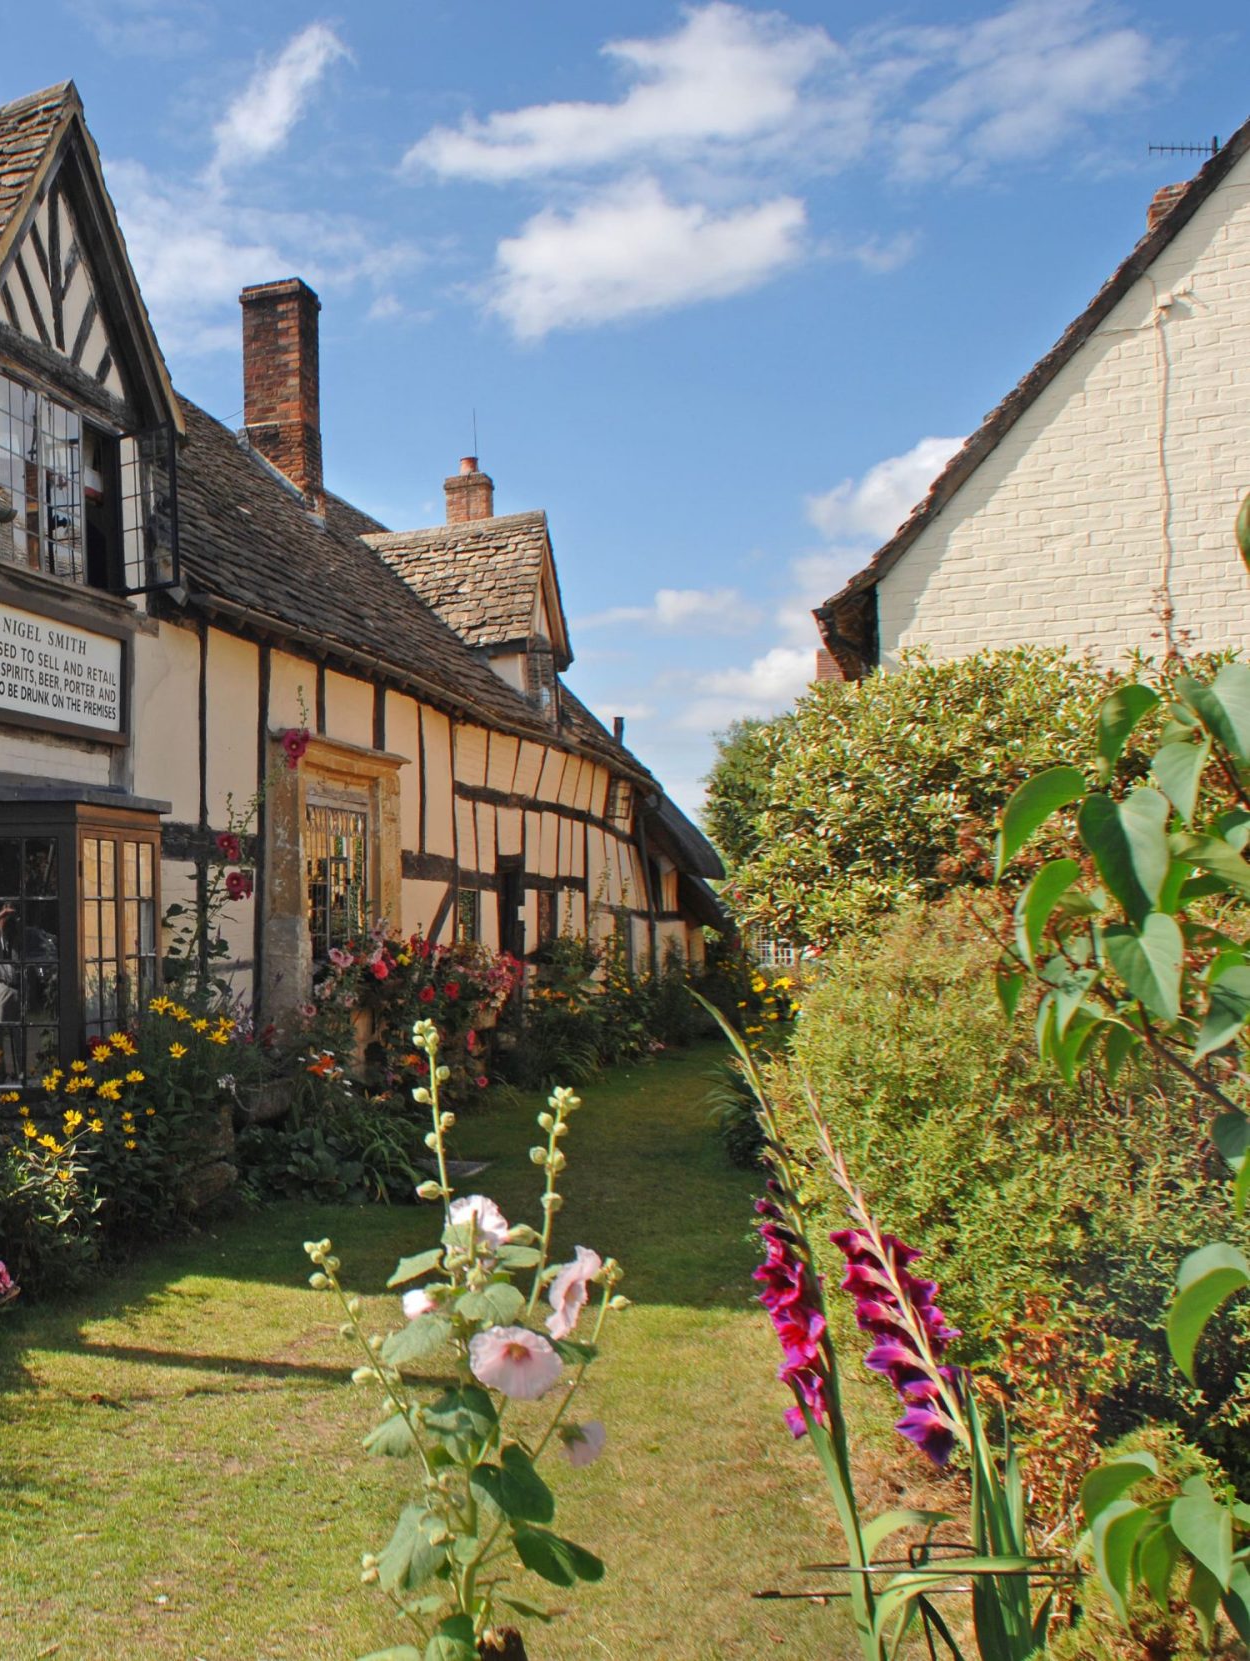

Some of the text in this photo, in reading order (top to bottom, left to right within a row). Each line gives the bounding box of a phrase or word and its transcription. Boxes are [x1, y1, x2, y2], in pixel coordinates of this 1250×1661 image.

[3, 617, 87, 655] NIGEL SMITH
[1, 662, 37, 686] SPIRITS,
[38, 672, 62, 693] BEER,
[64, 679, 95, 699] PORTER
[98, 688, 116, 703] AND
[21, 648, 34, 664] TO
[38, 652, 59, 671] SELL
[63, 660, 83, 677] AND
[87, 667, 116, 686] RETAIL
[8, 684, 18, 699] BE
[21, 686, 49, 706] DRUNK
[52, 693, 64, 708] ON
[66, 697, 81, 713] THE
[83, 701, 116, 720] PREMISES
